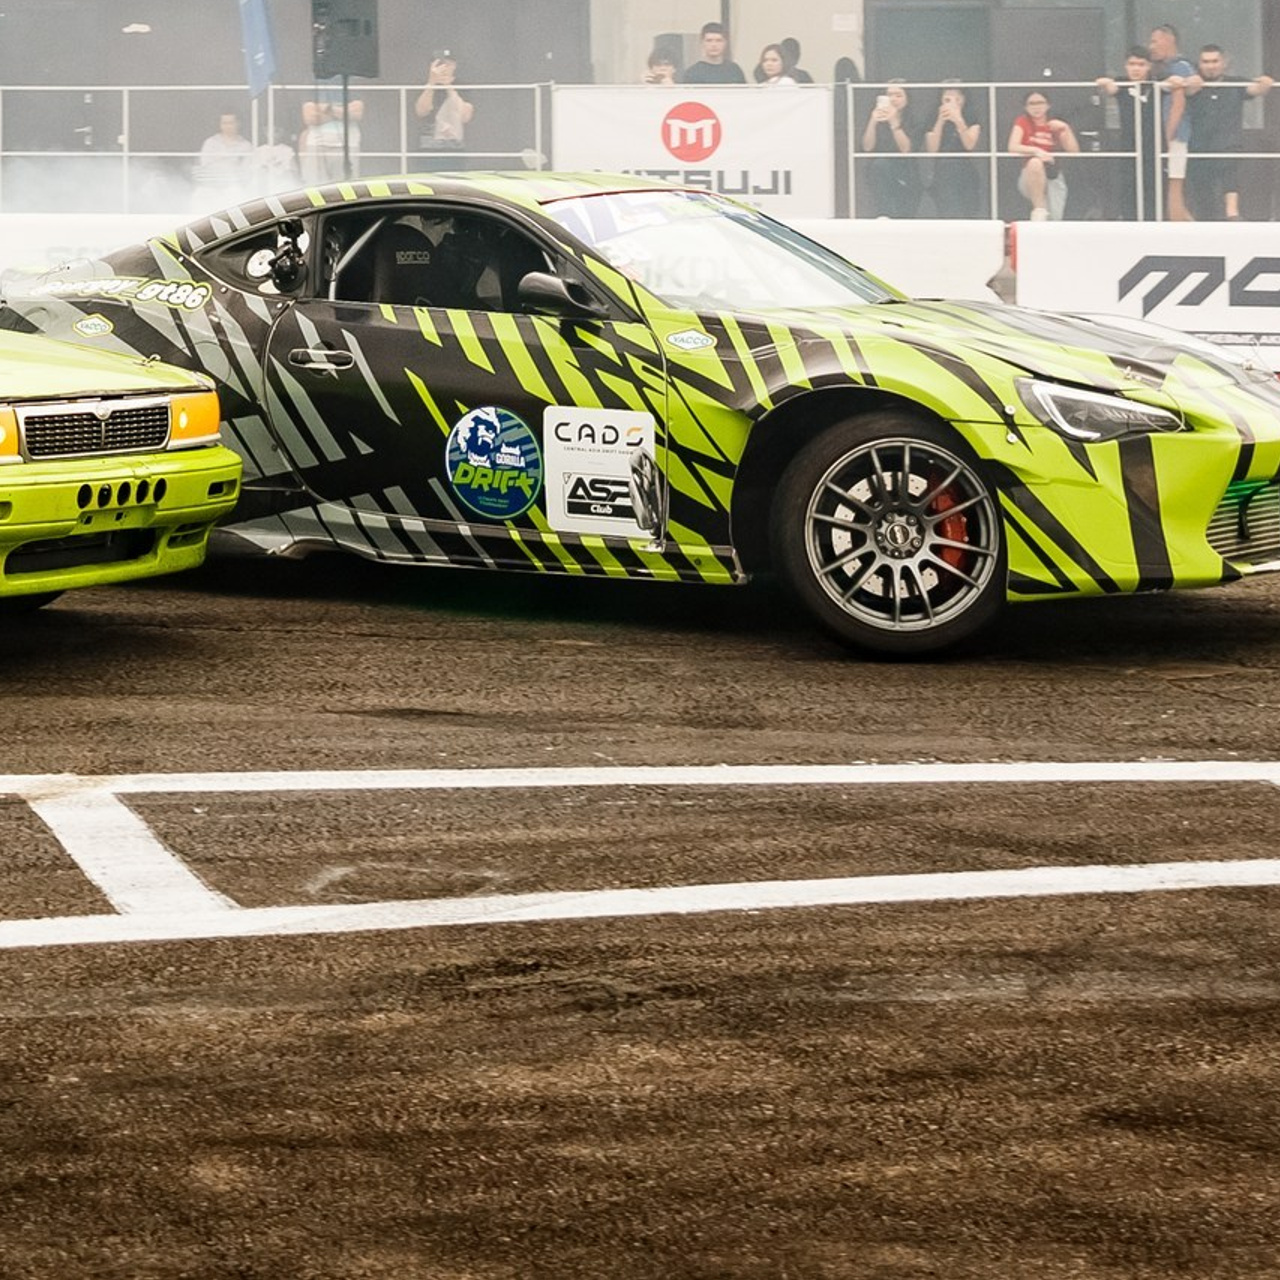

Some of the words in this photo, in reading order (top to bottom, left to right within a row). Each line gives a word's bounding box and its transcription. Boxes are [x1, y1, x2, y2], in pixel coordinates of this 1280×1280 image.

[594, 169, 792, 196] TSUJI
[136, 283, 209, 309] gt86
[673, 336, 709, 346] YACCO
[554, 422, 644, 447] CADS
[452, 461, 535, 500] DRIFT
[590, 504, 613, 515] Club
